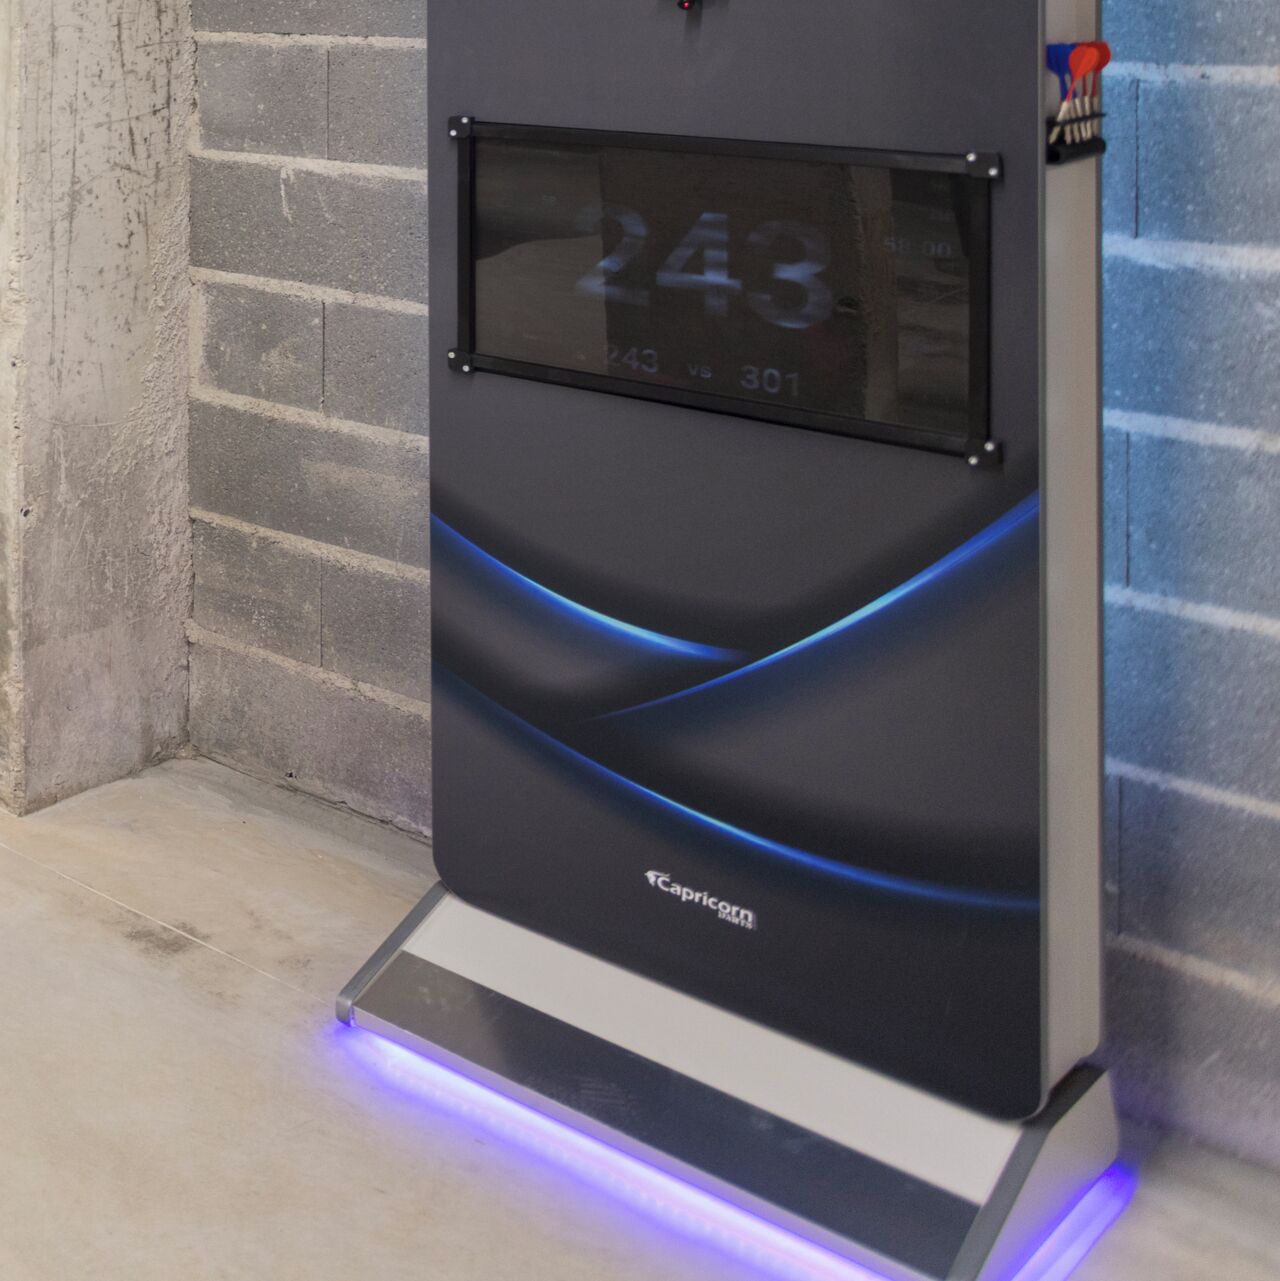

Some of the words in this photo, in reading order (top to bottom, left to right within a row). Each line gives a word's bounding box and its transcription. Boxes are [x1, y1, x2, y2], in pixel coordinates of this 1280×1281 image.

[574, 208, 834, 331] 243
[739, 365, 801, 397] 301
[656, 875, 754, 923] Capricorn
